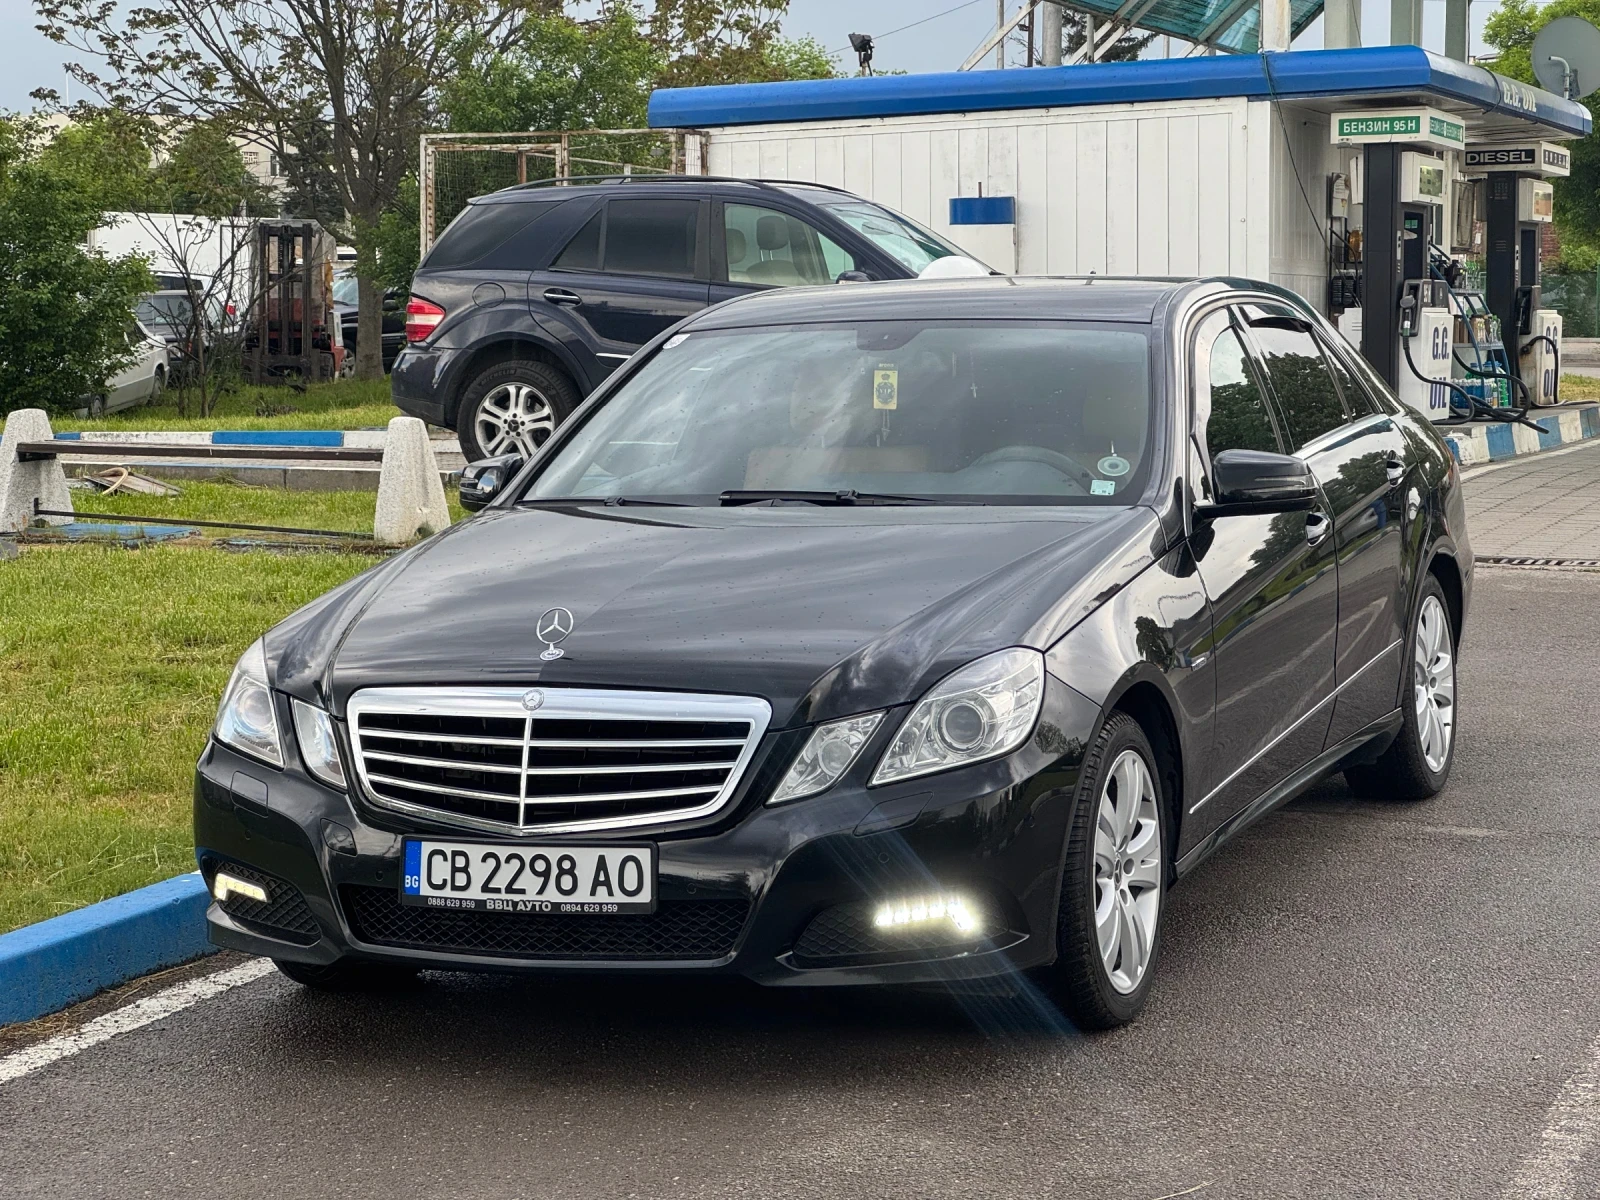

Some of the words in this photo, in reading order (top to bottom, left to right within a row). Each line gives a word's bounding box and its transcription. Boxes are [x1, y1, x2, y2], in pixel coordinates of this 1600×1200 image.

[1502, 81, 1521, 108] G.G.
[1522, 88, 1537, 113] OIL
[1343, 121, 1390, 133] БЕНЗИН
[1466, 151, 1533, 164] DIESEL
[1432, 326, 1450, 360] G.G.
[1543, 368, 1558, 397] OI
[1429, 376, 1447, 410] OIL
[426, 848, 472, 892] CB
[480, 851, 579, 897] 2298
[404, 875, 419, 888] BG
[427, 897, 446, 907] 0888
[446, 899, 460, 908] 629
[461, 900, 476, 909] 959
[486, 899, 514, 911] ВВЦ
[516, 900, 552, 912] АУТО
[560, 903, 581, 912] 0894
[583, 904, 600, 912] 629
[601, 904, 618, 912] 959
